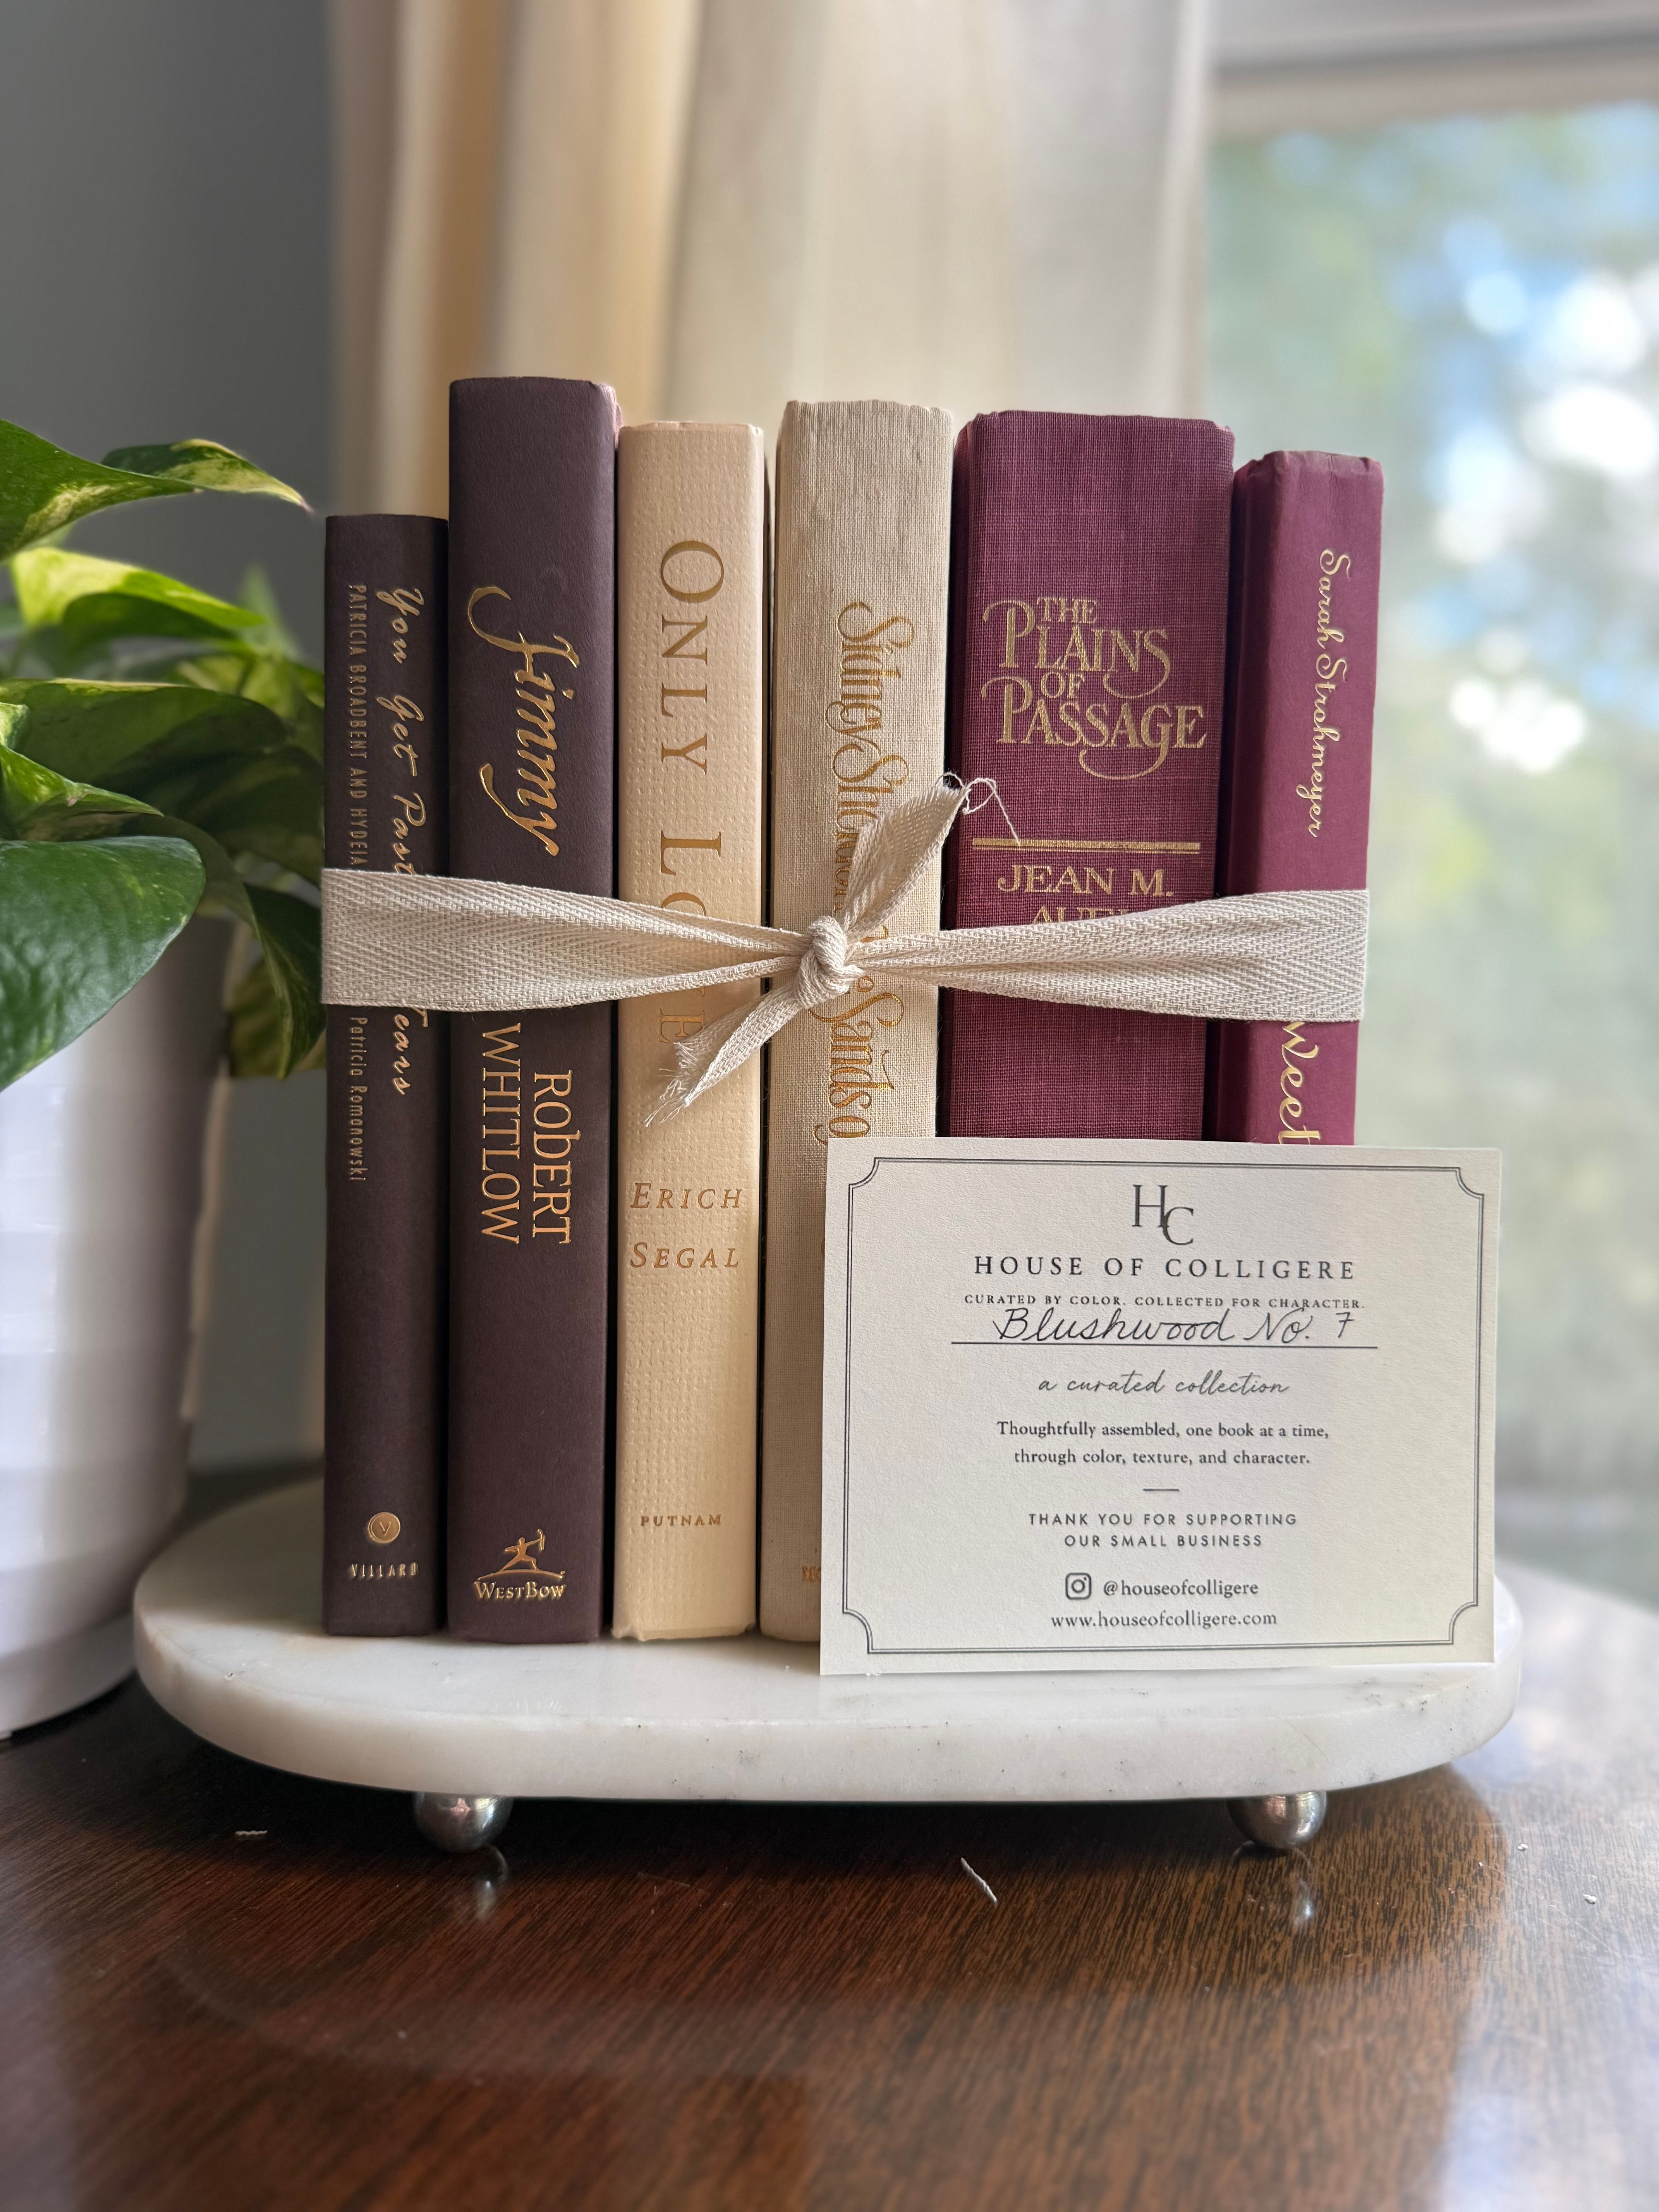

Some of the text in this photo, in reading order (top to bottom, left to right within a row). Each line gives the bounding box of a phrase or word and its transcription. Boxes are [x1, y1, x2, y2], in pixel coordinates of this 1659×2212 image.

[376, 587, 424, 664] You
[1037, 597, 1098, 624] THE
[983, 600, 1171, 699] PLAINS
[824, 602, 915, 751] Sidney
[1041, 672, 1085, 699] OF
[1296, 549, 1351, 837] Sarah Strohmeyer
[349, 585, 367, 866] PATRICIA BROADBENT AND HYDEIA
[376, 696, 424, 776] Get
[468, 586, 580, 856] Jimmy
[981, 676, 1207, 780] PASSAGE
[659, 540, 724, 1043] ONLY LE
[998, 864, 1173, 897] JEAN M.
[809, 993, 905, 1109] Sands
[350, 1017, 368, 1181] Patricia Romanowski
[482, 1023, 521, 1244] WHITLOW
[630, 1183, 742, 1209] ERICH
[1131, 1184, 1194, 1246] HC
[630, 1242, 738, 1268] SEGAL
[974, 1256, 1356, 1279] HOUSE OF COLLIGERE
[964, 1294, 1365, 1309] CURATED BY COLOR. COLLECTED FOR CHARACTER.
[992, 1307, 1355, 1344] Blushwood No. 7
[1038, 1370, 1291, 1395] a curated collection
[997, 1420, 1329, 1439] Thoughtfully assembled, one book at a time,
[1014, 1449, 1310, 1466] through color, texture, and character.
[641, 1514, 721, 1527] PUTNAM
[1029, 1513, 1297, 1525] THANK YOU FOR SUPPORTING
[1064, 1535, 1262, 1547] OUR SMALL BUSINESS
[349, 1561, 419, 1578] VILLARD
[1103, 1579, 1259, 1598] @houseofcolligere
[1050, 1610, 1277, 1629] www.houseofcolligere.com
